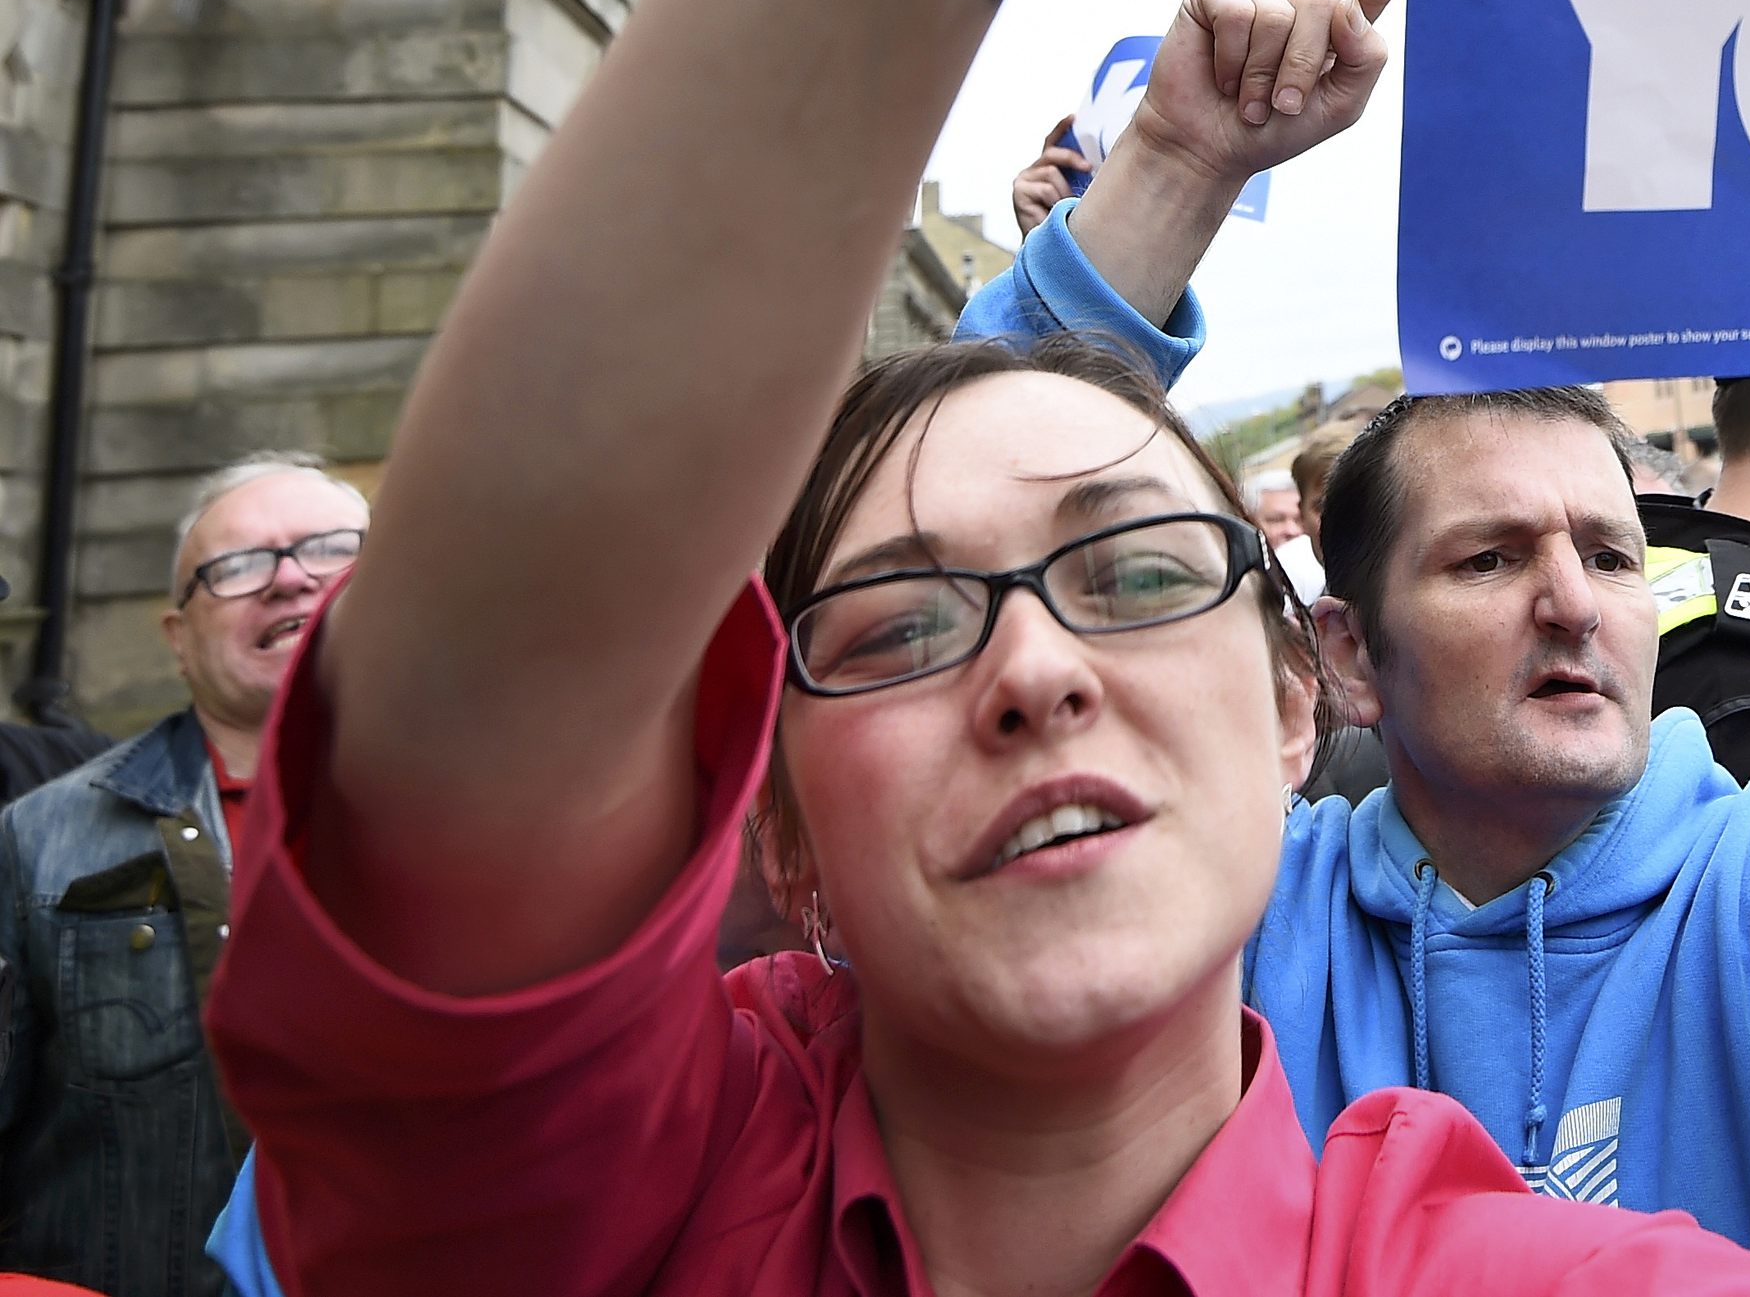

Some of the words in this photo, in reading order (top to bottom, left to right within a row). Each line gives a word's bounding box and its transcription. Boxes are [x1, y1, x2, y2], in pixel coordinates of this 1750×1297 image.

[1470, 337, 1509, 354] Please
[1510, 335, 1554, 353] display
[1555, 333, 1578, 350] this
[1579, 332, 1626, 348] window
[1628, 331, 1665, 348] poster
[1666, 330, 1679, 344] to
[1681, 328, 1711, 344] show
[1712, 328, 1739, 344] your
